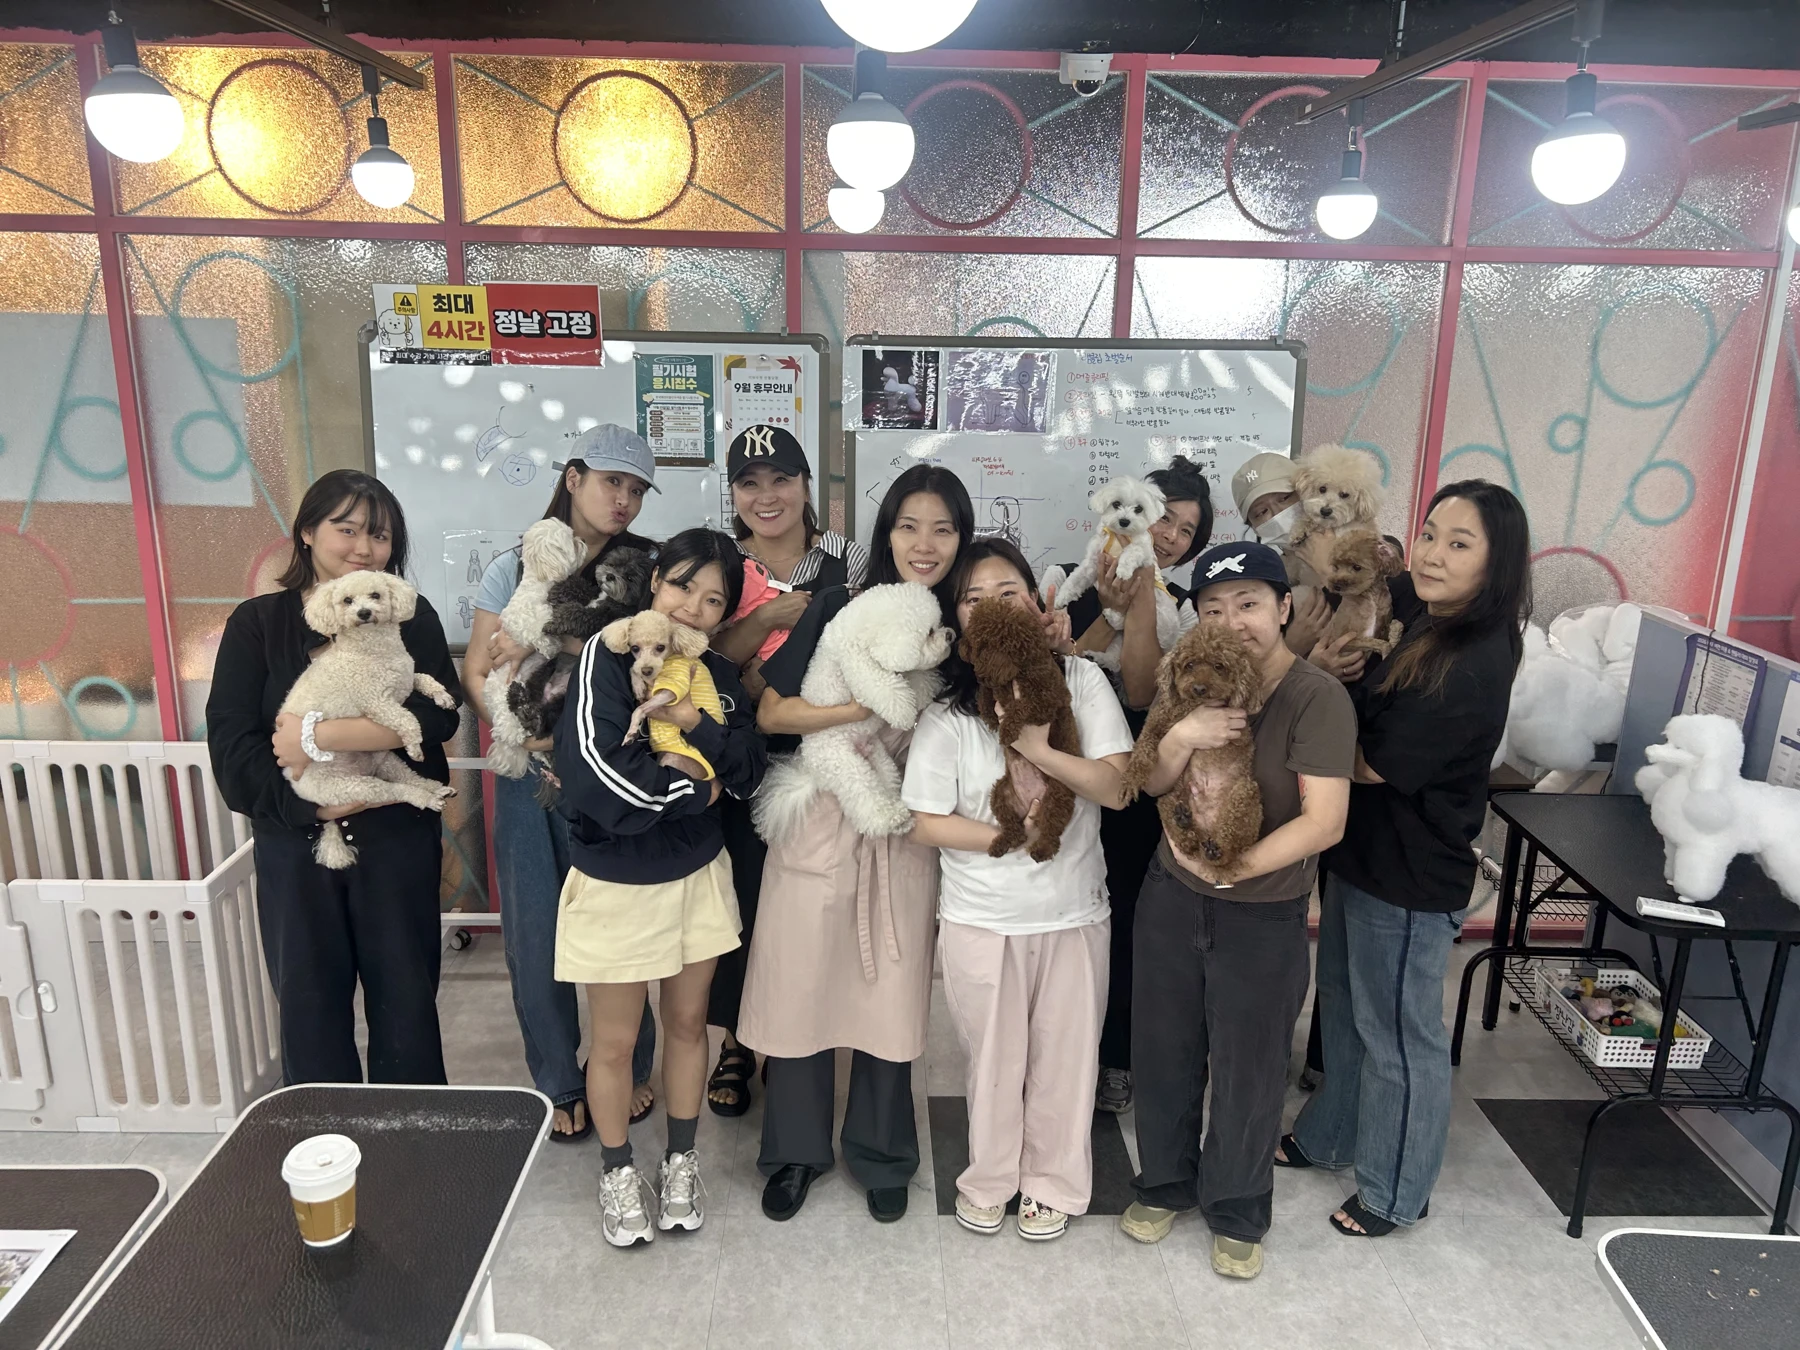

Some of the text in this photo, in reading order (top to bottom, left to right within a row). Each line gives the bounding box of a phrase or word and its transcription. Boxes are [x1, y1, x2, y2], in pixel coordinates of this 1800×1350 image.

[432, 293, 474, 315] 최대
[427, 320, 485, 342] 4시간
[494, 310, 593, 337] 정날 고정
[652, 364, 697, 377] 필기시험
[652, 377, 698, 390] 응시접수
[734, 382, 793, 394] 9월 휴무안내
[743, 425, 776, 458] NY
[1554, 1003, 1576, 1035] 장난감
